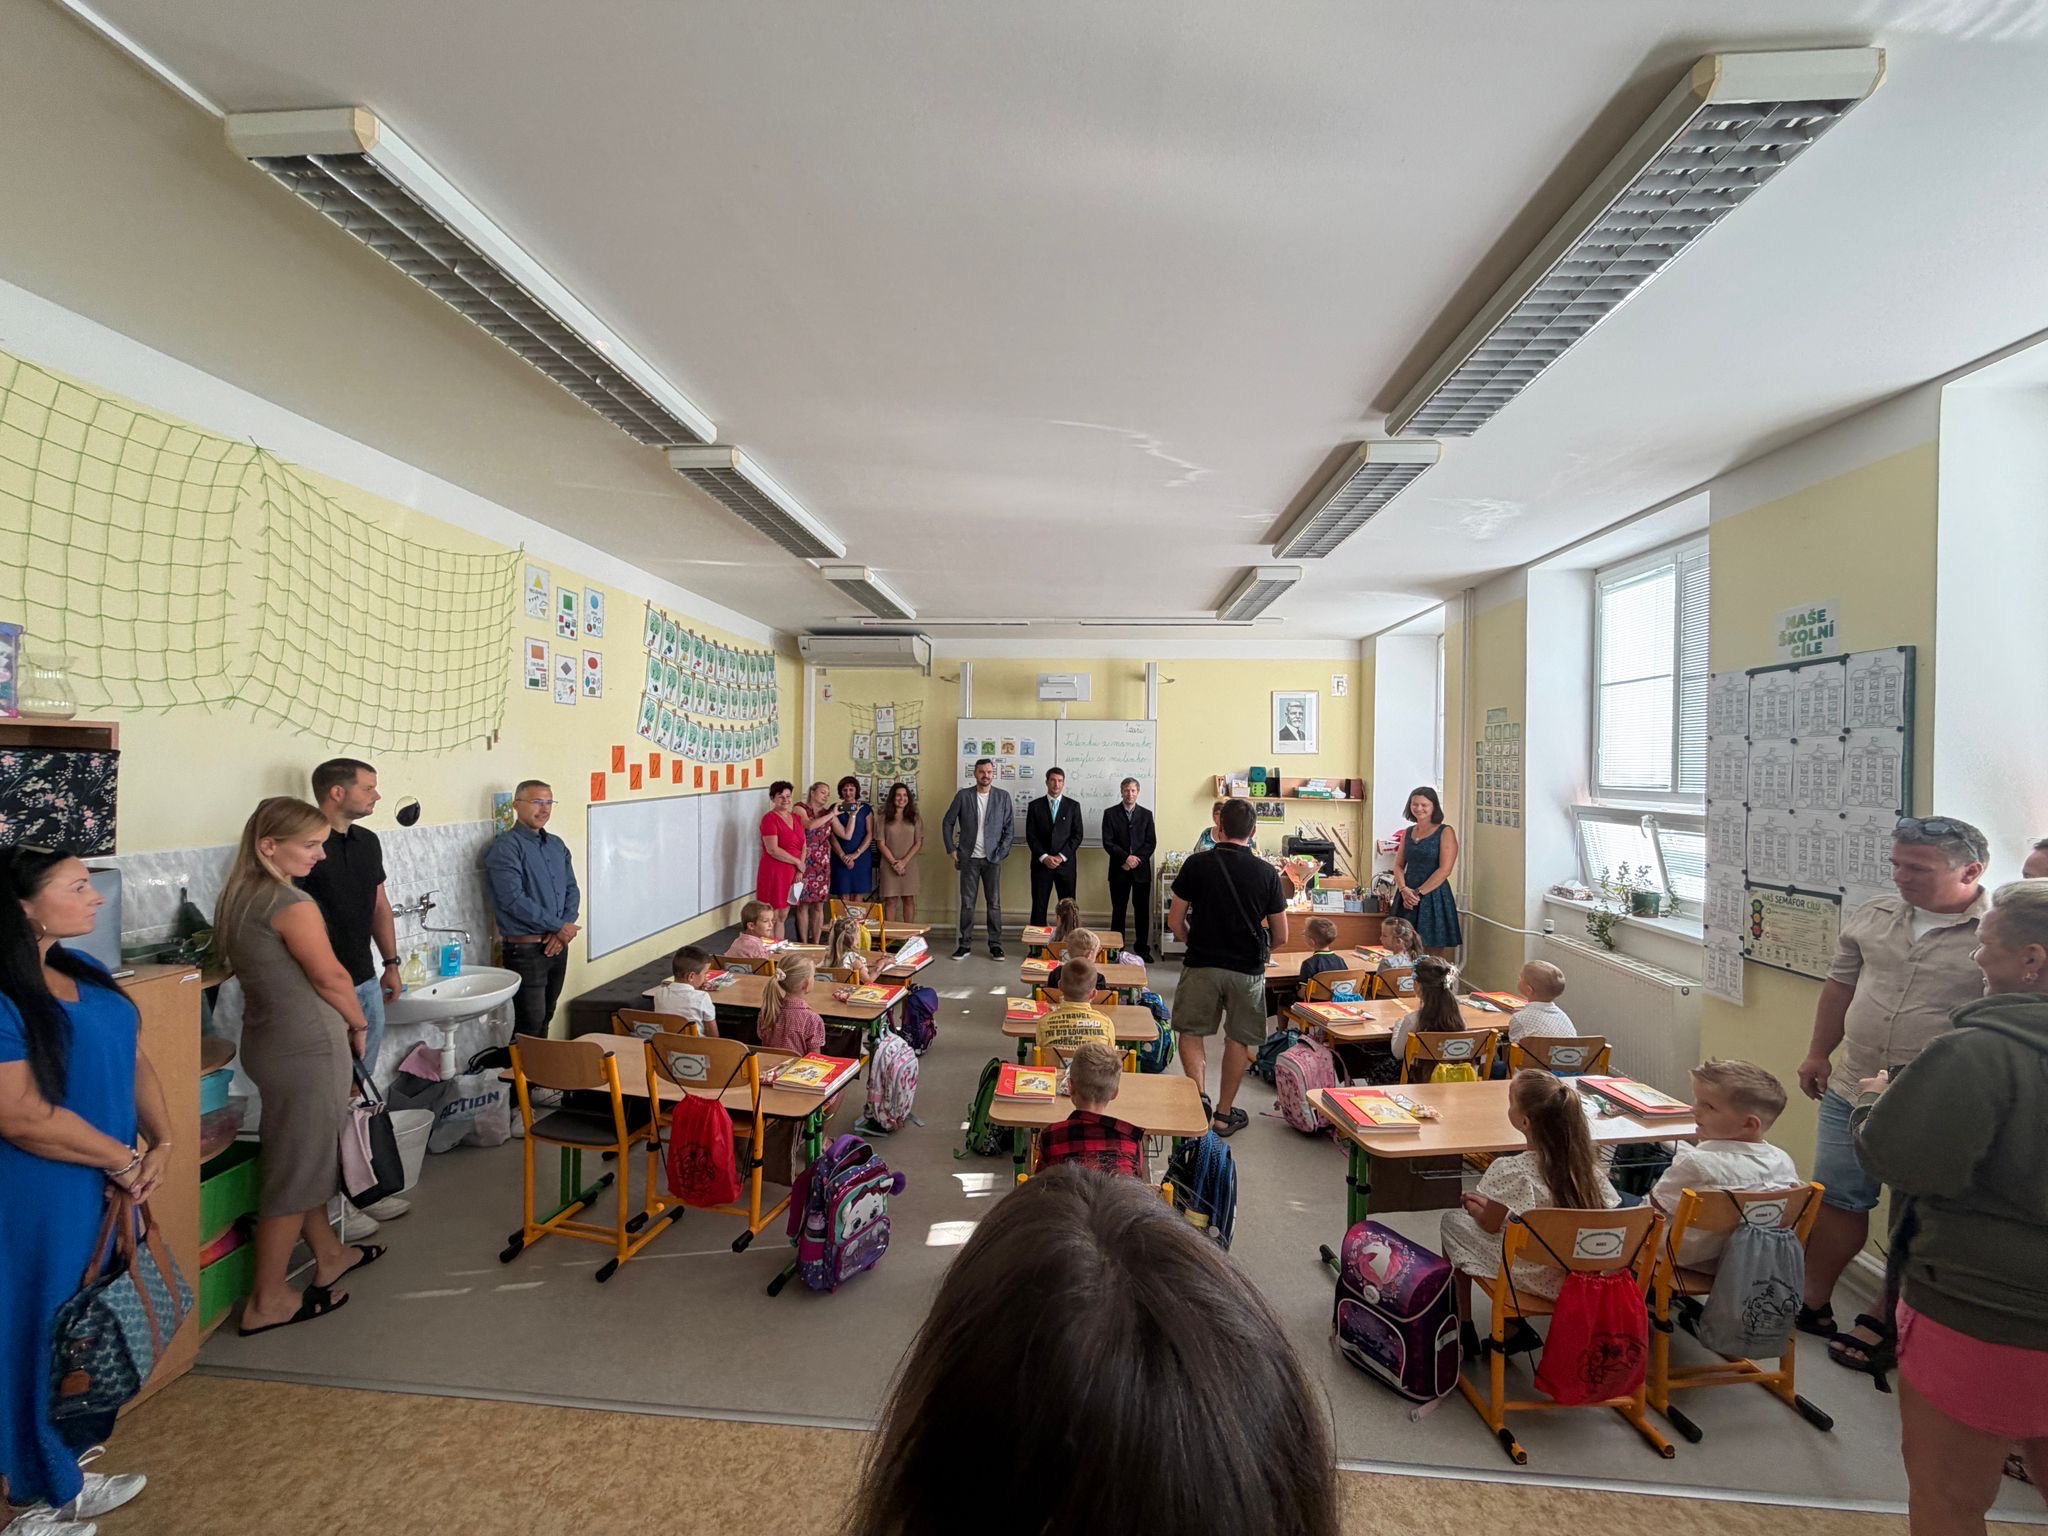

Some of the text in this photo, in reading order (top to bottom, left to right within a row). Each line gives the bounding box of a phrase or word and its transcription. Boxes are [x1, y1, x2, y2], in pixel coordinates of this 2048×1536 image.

[1785, 608, 1827, 630] NAŠE
[1779, 620, 1834, 646] ŠKOLNÍ
[1791, 641, 1823, 658] CÍLE
[1775, 894, 1805, 908] SEMAFOR
[1067, 1028, 1105, 1036] ADVENTURE
[439, 1090, 500, 1120] ACTION
